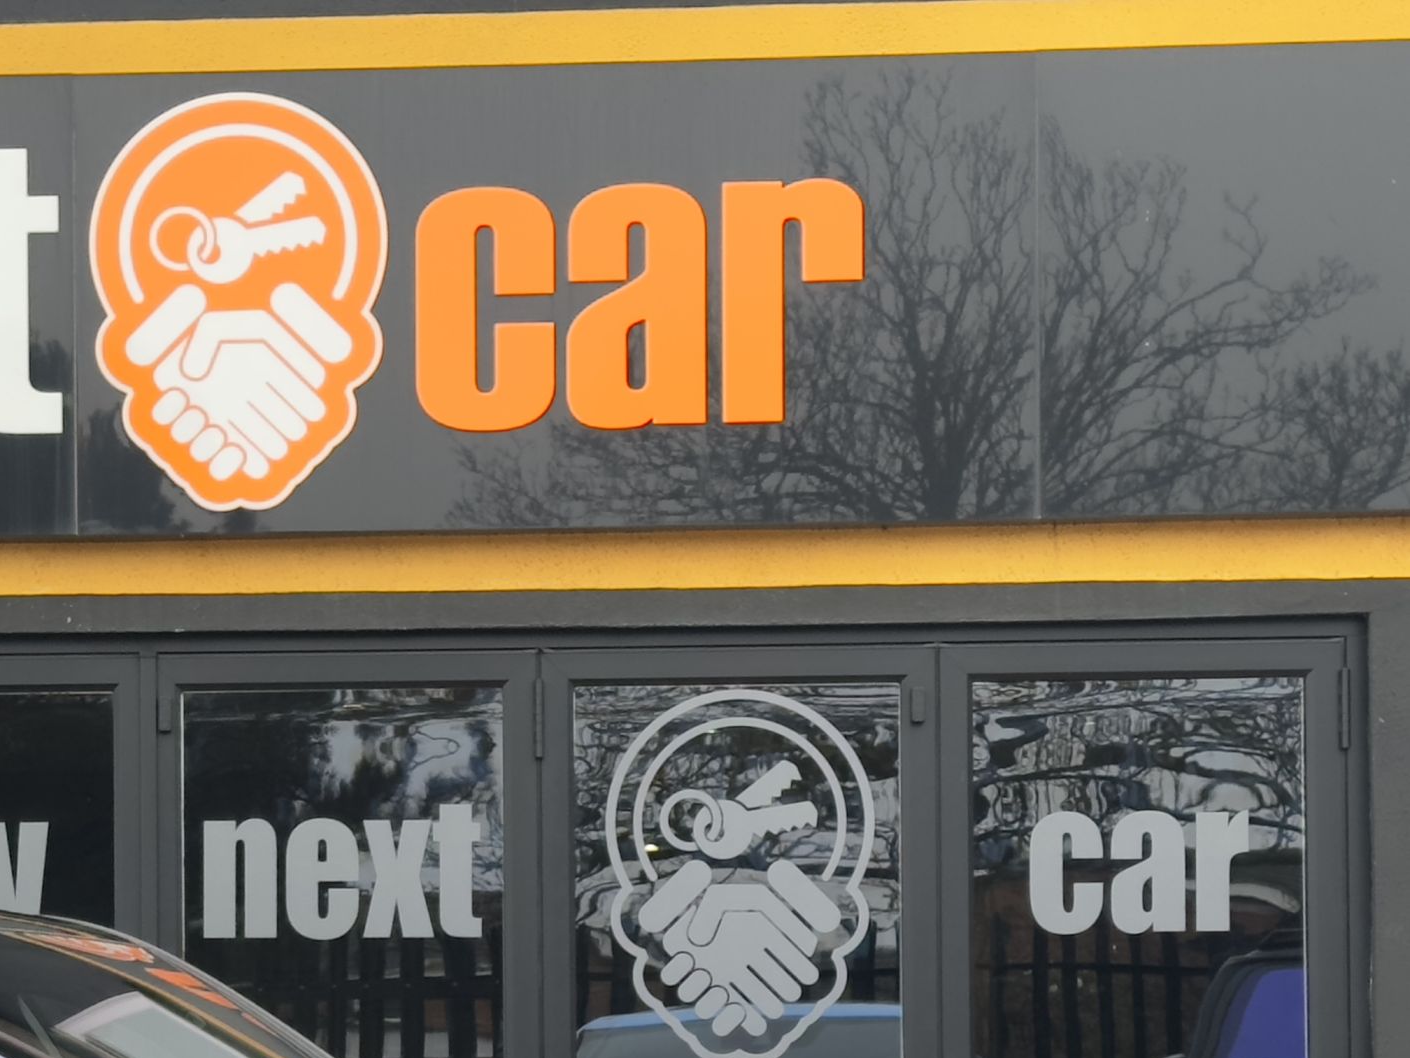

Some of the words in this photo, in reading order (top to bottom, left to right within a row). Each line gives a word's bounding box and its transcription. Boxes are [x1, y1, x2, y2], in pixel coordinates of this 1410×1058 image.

[416, 179, 865, 431] car
[203, 803, 483, 941] next
[1029, 810, 1250, 936] car
